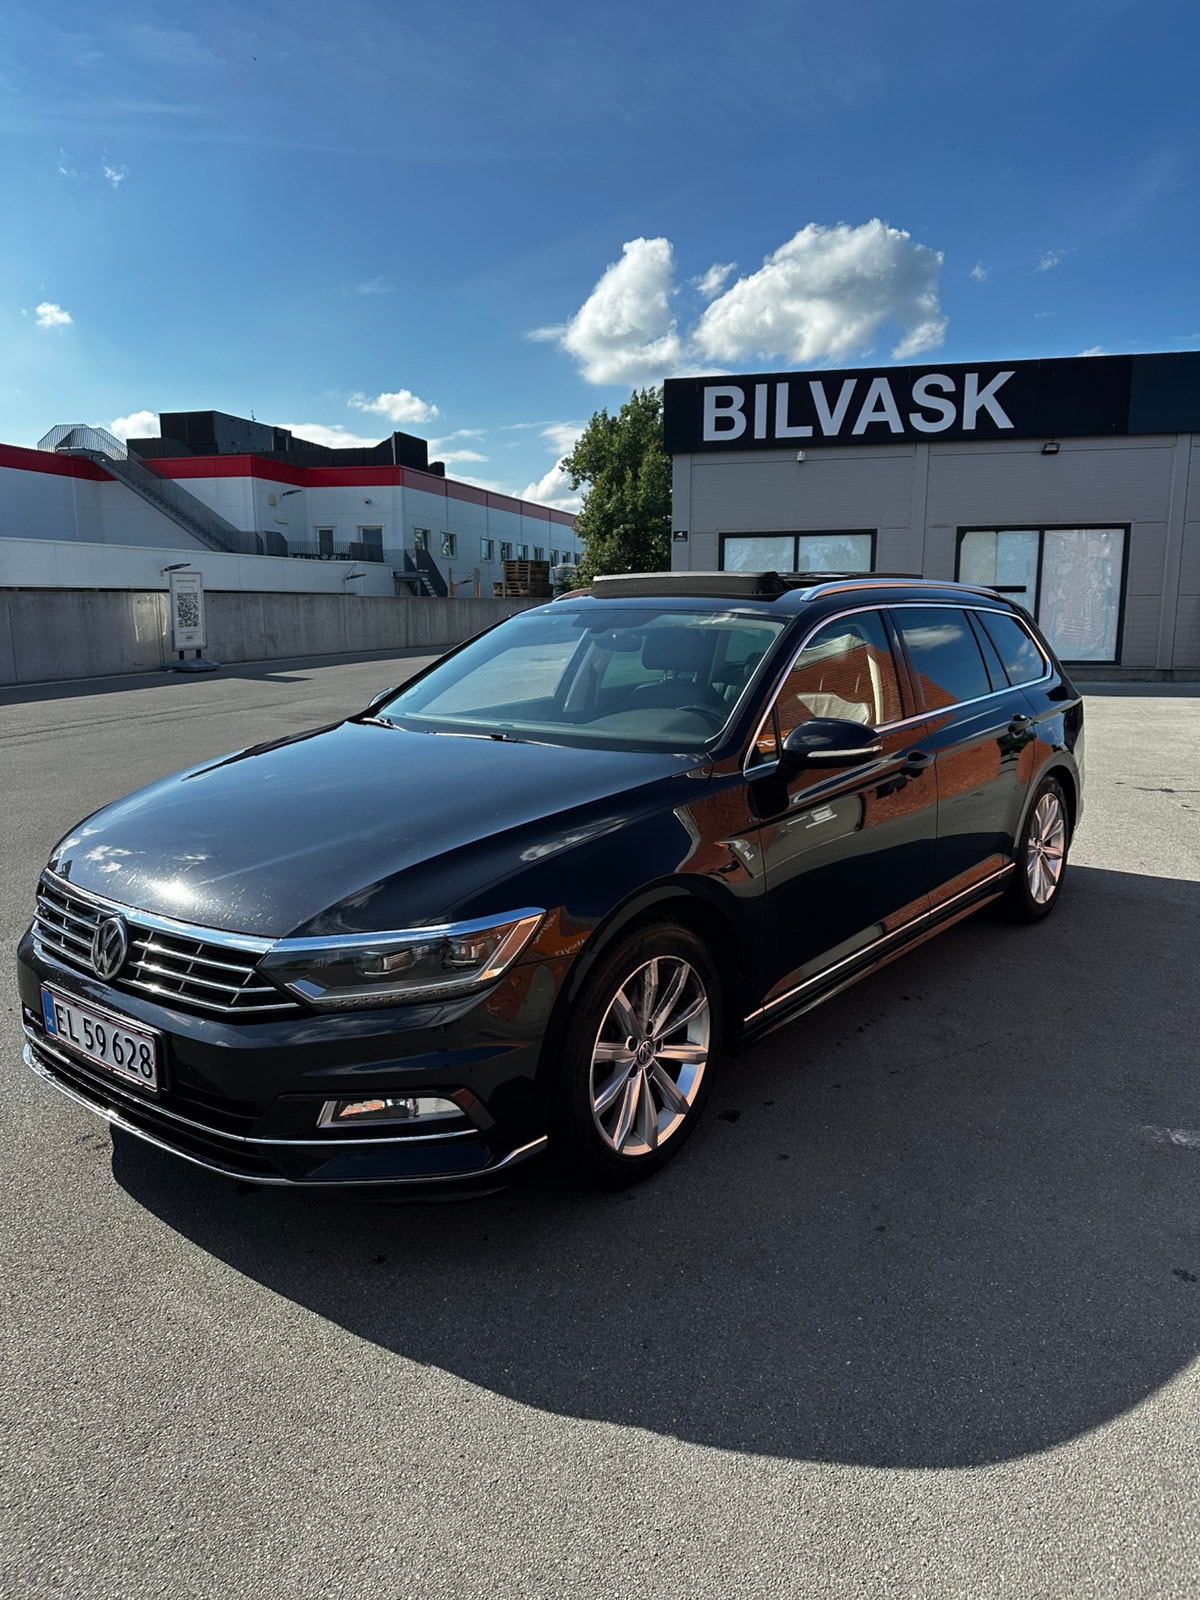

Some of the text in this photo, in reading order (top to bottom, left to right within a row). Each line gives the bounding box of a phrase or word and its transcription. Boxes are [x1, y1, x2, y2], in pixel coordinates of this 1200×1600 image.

[703, 370, 1016, 441] BILVASK
[55, 1003, 153, 1079] EL 59 628
